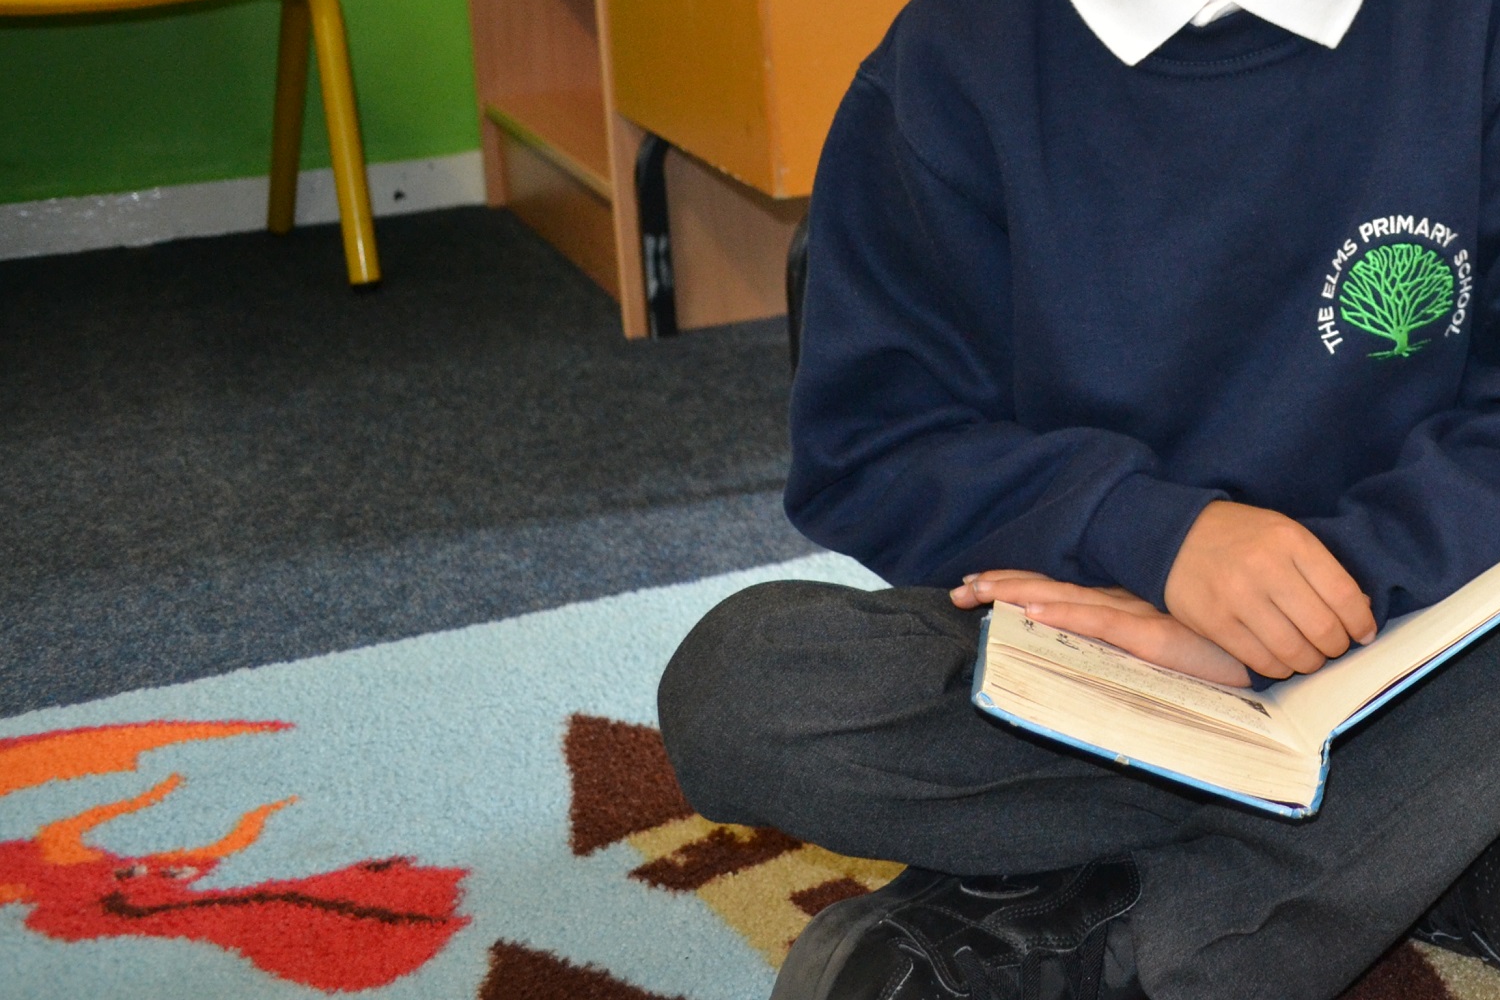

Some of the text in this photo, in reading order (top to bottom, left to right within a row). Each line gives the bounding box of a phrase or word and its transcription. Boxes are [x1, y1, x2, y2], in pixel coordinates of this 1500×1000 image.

[1317, 214, 1473, 354] THE ELMS PRIMARY SCHOOL
